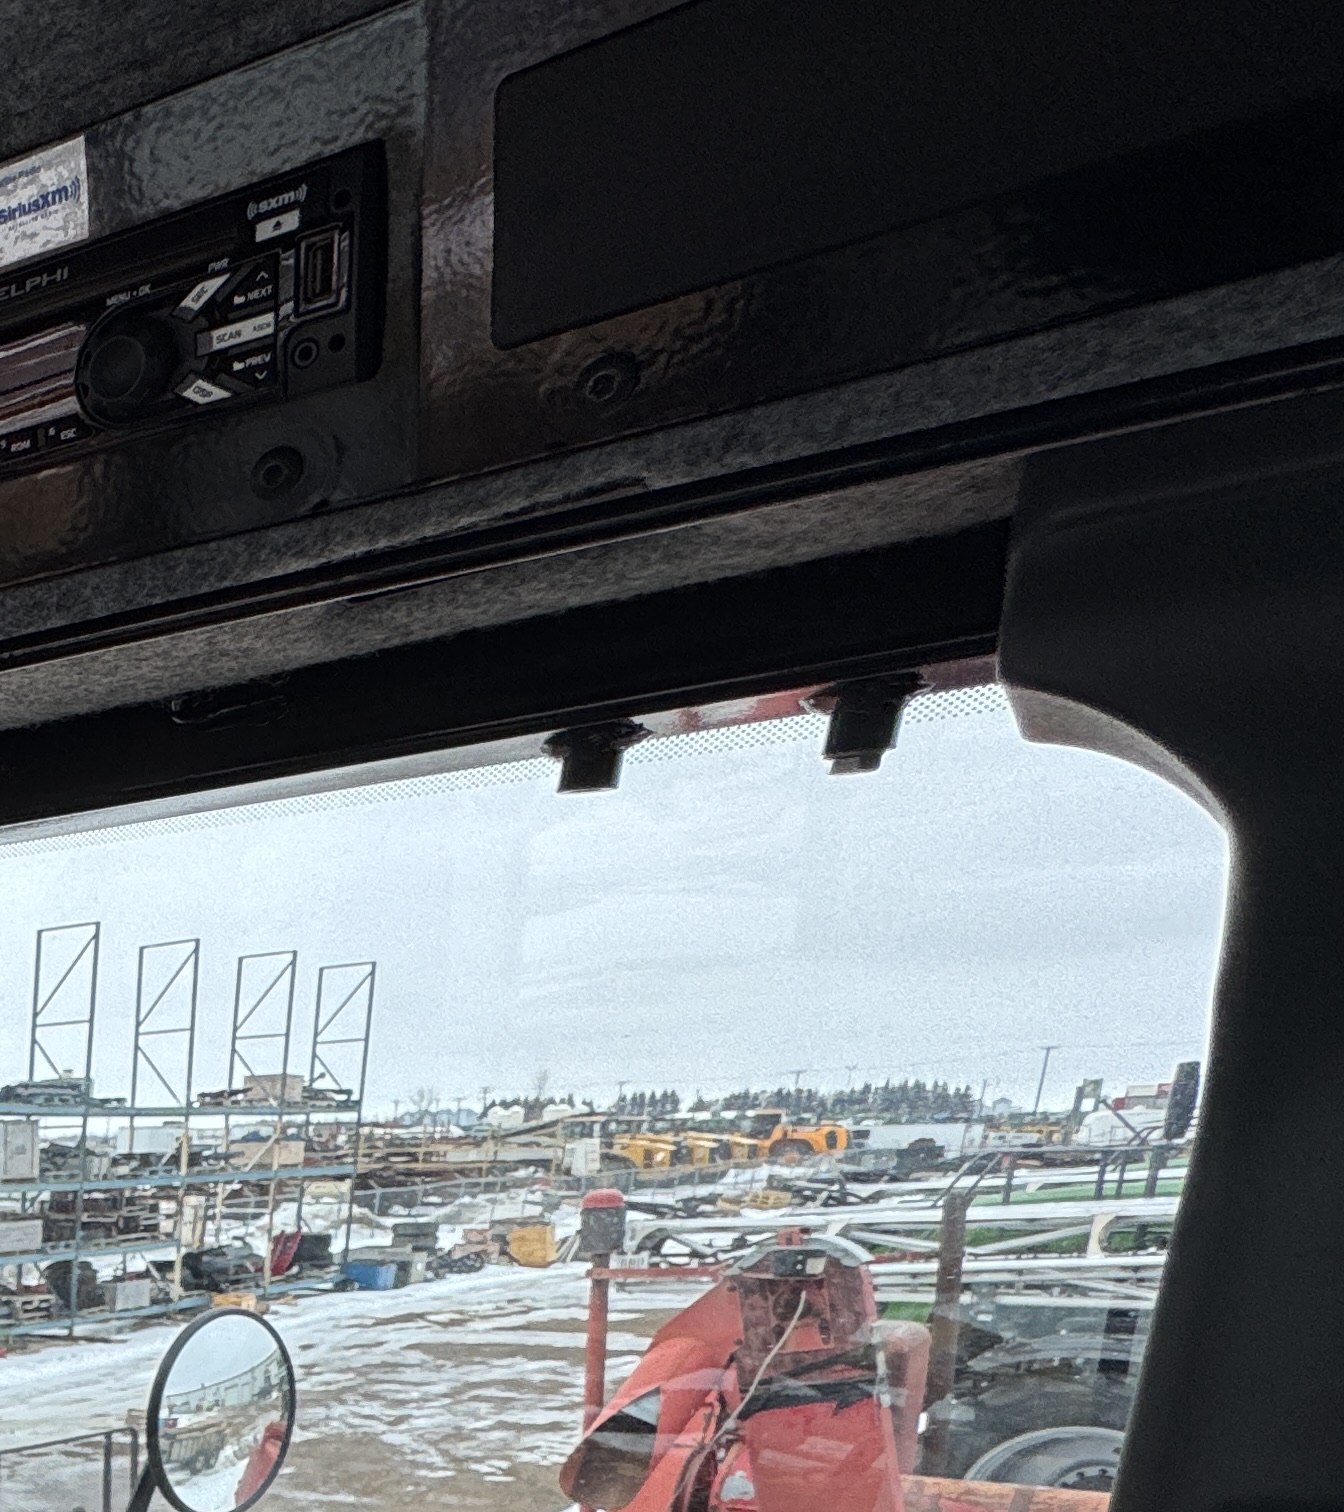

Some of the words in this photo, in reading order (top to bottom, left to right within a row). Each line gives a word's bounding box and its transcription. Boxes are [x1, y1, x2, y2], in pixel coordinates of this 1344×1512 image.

[247, 285, 273, 301] NEXT
[215, 329, 242, 344] SCAN
[245, 352, 272, 369] PREV
